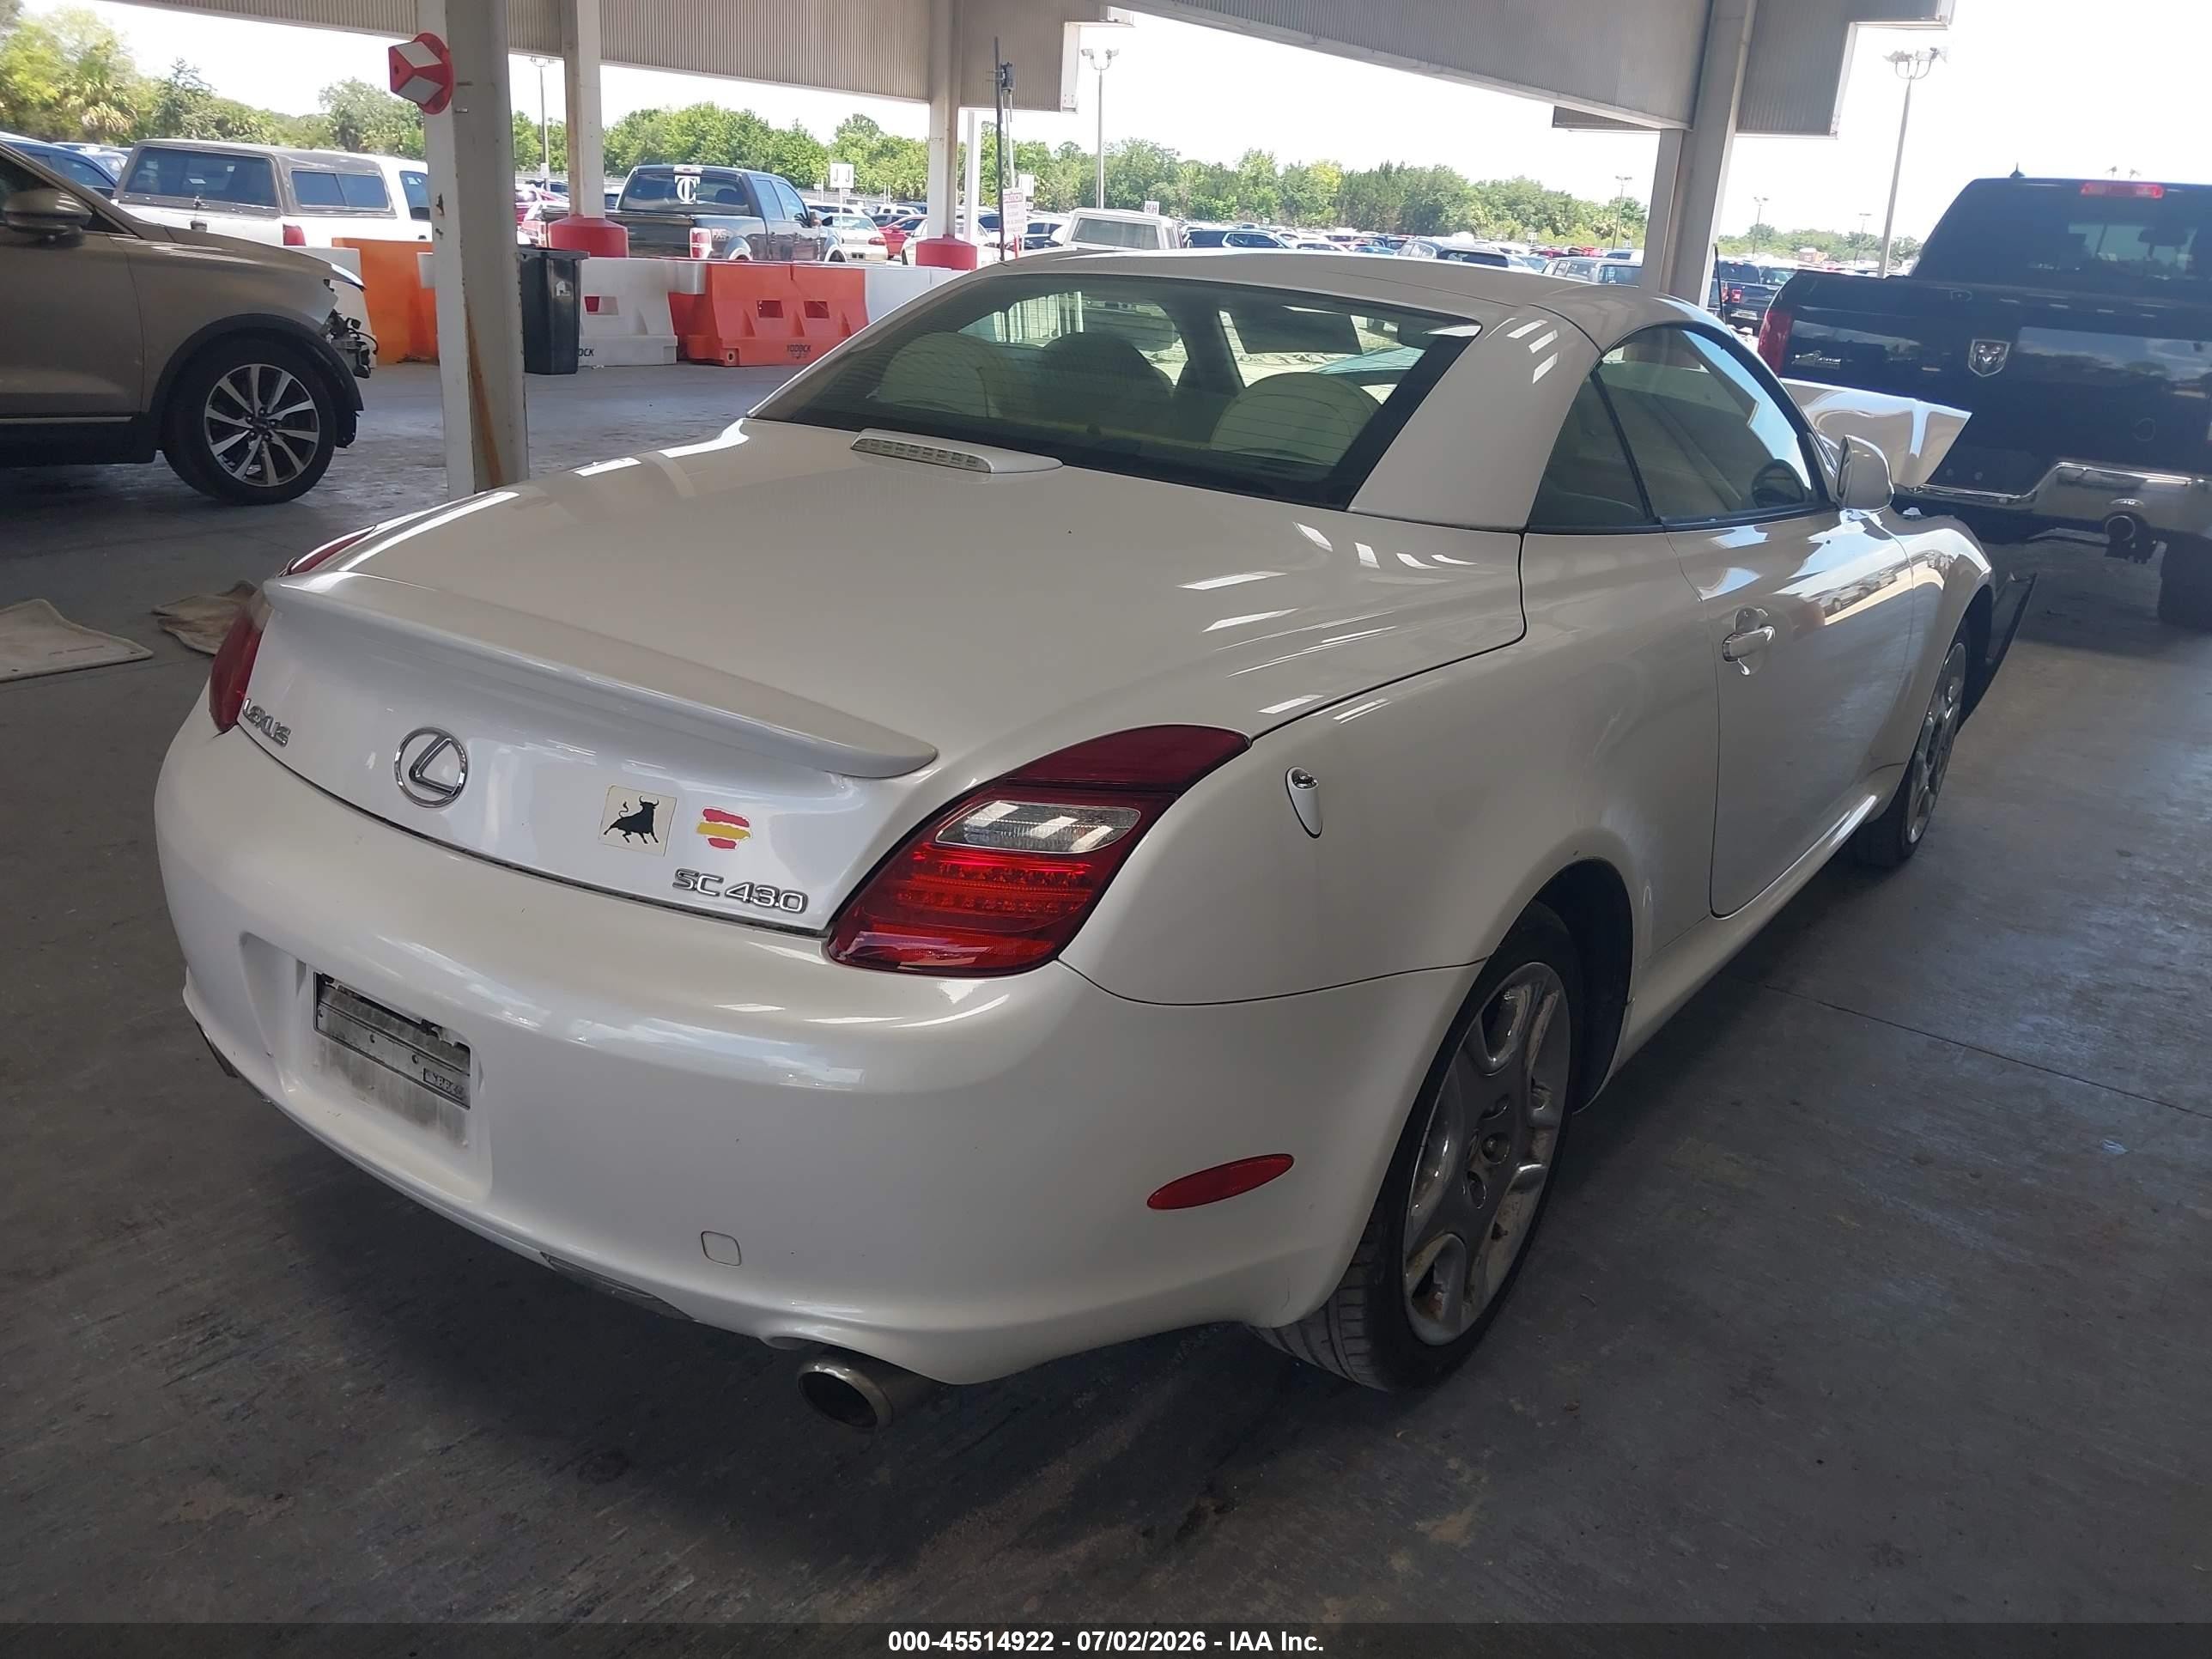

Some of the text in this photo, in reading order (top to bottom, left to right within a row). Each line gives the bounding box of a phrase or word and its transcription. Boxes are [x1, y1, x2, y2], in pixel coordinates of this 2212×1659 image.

[243, 698, 291, 747] LEXUS
[672, 867, 809, 914] SC 430
